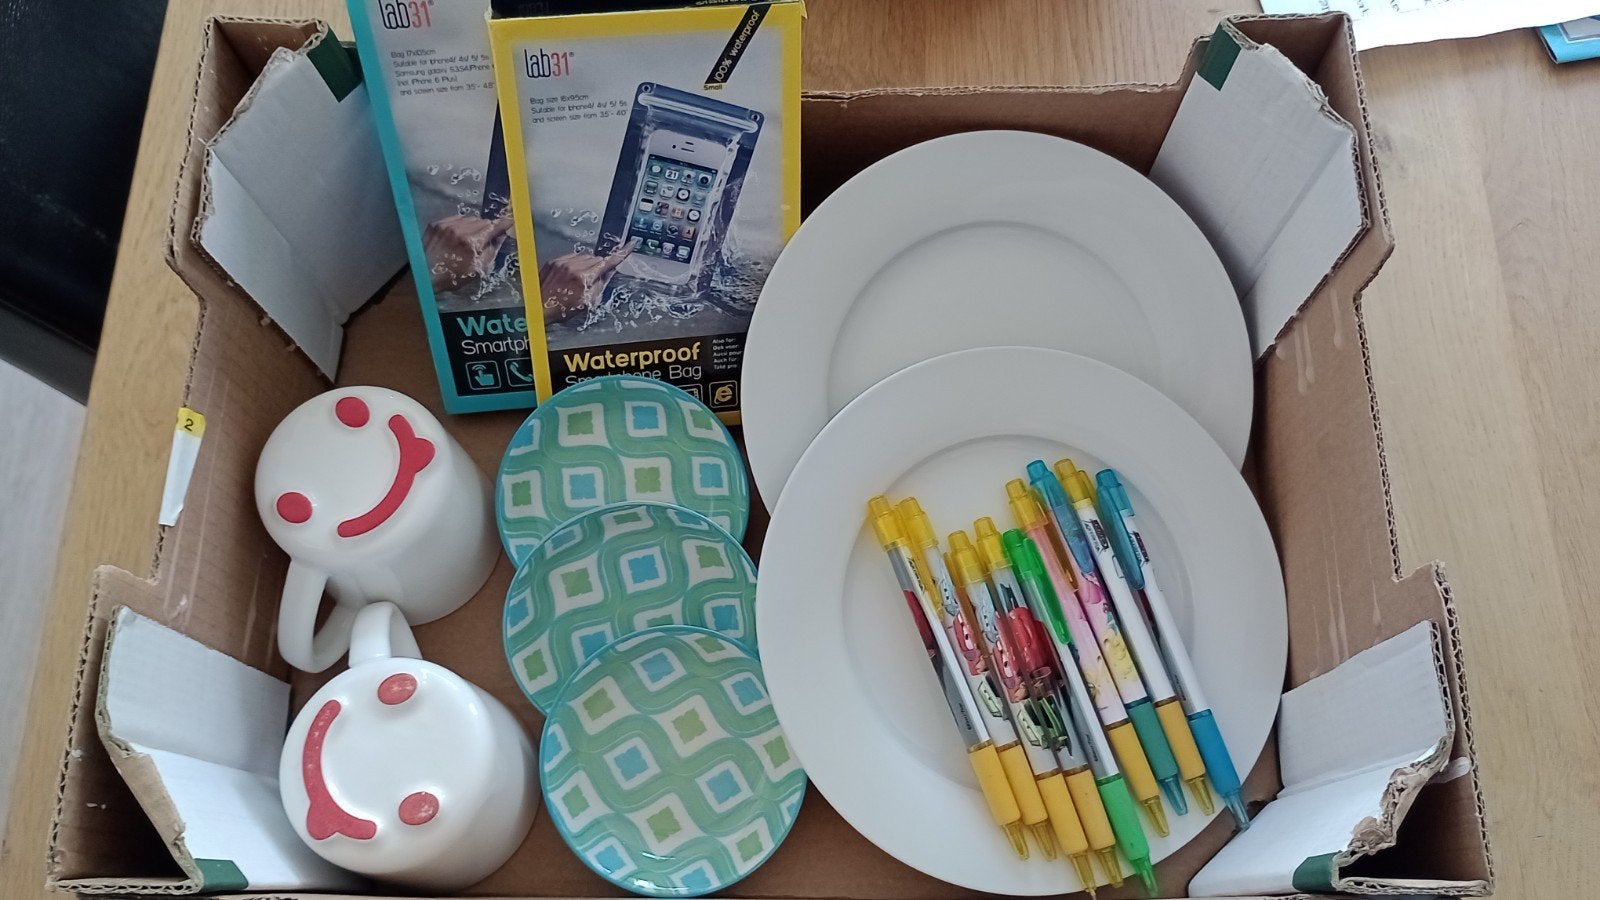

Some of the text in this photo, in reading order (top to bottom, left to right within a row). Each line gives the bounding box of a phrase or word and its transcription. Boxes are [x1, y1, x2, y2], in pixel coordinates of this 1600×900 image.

[713, 9, 761, 82] 100% waterproof
[392, 58, 417, 68] Suitable
[395, 69, 425, 78] Samsung
[413, 87, 434, 96] screen
[436, 86, 448, 94] size
[450, 84, 464, 92] from
[529, 96, 544, 105] Bag
[546, 95, 558, 103] size
[530, 106, 556, 115] Suitable
[532, 116, 545, 124] and
[546, 114, 566, 122] screen
[569, 113, 581, 121] size
[583, 111, 597, 119] from
[563, 342, 701, 373] Waterproof
[669, 364, 702, 380] Bag
[184, 418, 194, 432] 2
